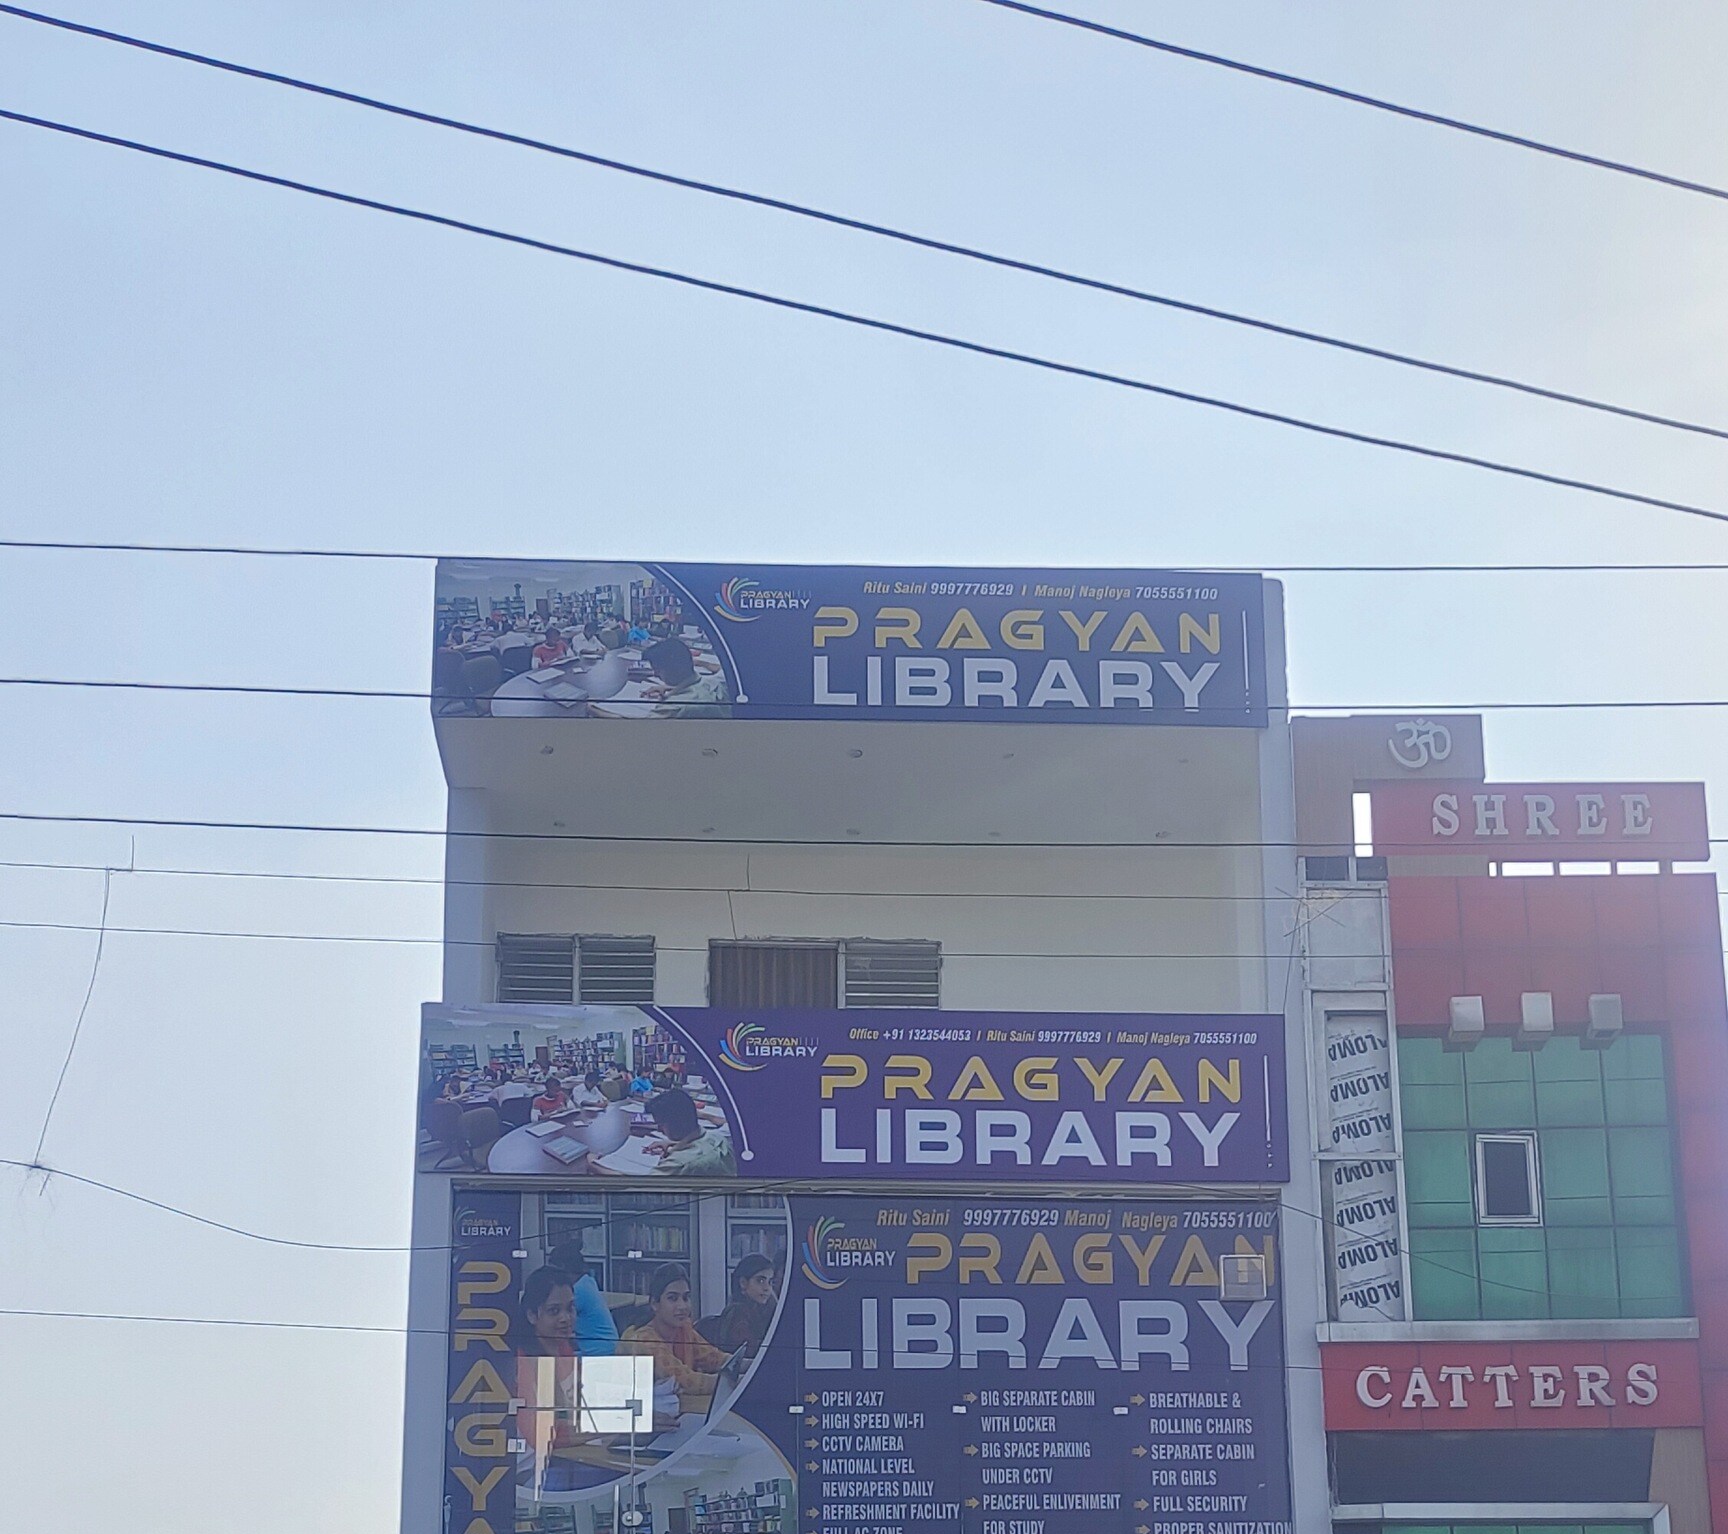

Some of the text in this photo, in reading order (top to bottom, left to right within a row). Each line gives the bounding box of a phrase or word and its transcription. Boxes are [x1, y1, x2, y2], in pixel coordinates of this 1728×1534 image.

[740, 591, 792, 599] PRAGYAN
[863, 581, 889, 594] Ritu
[893, 581, 927, 594] Saini
[931, 582, 1013, 596] 9997776929
[1035, 584, 1074, 599] Manoj
[1135, 586, 1218, 600] 7055551100
[740, 599, 810, 610] LIBRARY
[813, 607, 1220, 656] PRAGYAN
[813, 655, 1220, 712] LIBRARY
[1432, 793, 1652, 835] SHREE
[746, 1037, 798, 1046] PRAGYAN
[849, 1028, 1257, 1046] Office +91 1323544053 Ritu Saini 9997776929 Manoj Nagleya 7055551100
[746, 1046, 817, 1057] LIBRARY
[820, 1054, 1241, 1103] PRAGYAN
[820, 1108, 1241, 1167] LIBRARY
[877, 1209, 1273, 1231] Ritu Saini 9997776929 Manoj Nagleya 7055551100
[461, 1226, 512, 1236] LIBRARY
[827, 1238, 877, 1249] PRAGYAN
[827, 1251, 895, 1267] LIBRARY
[907, 1232, 1275, 1286] PRAGYAN
[804, 1298, 1275, 1371] LIBRARY
[1355, 1362, 1658, 1408] CATTERS
[822, 1391, 884, 1407] OPEN 24X7
[981, 1391, 1095, 1406] BIG SEPARATE CABIN
[1150, 1393, 1241, 1408] BREATHABLE &
[822, 1413, 924, 1429] HIGH SPEED WI-FI
[981, 1416, 1056, 1432] WITH LOCKER
[1150, 1418, 1253, 1434] ROLLING CHAIRS
[822, 1436, 904, 1452] CCTV CAMERA
[981, 1442, 1091, 1458] BIG SPACE PARKING
[1151, 1444, 1255, 1460] SEPARATE CABIN
[822, 1458, 915, 1474] NATIONAL LEVEL
[982, 1468, 1053, 1484] UNDER CCTV
[1152, 1470, 1217, 1486] FOR GIRLS
[822, 1481, 934, 1497] NEWSPAPERS DAILY
[983, 1494, 1121, 1510] PEACEFUL ENLIVENMENT
[1153, 1496, 1248, 1512] FULL SECURITY
[822, 1503, 960, 1520] REFRESHMENT FACILITY
